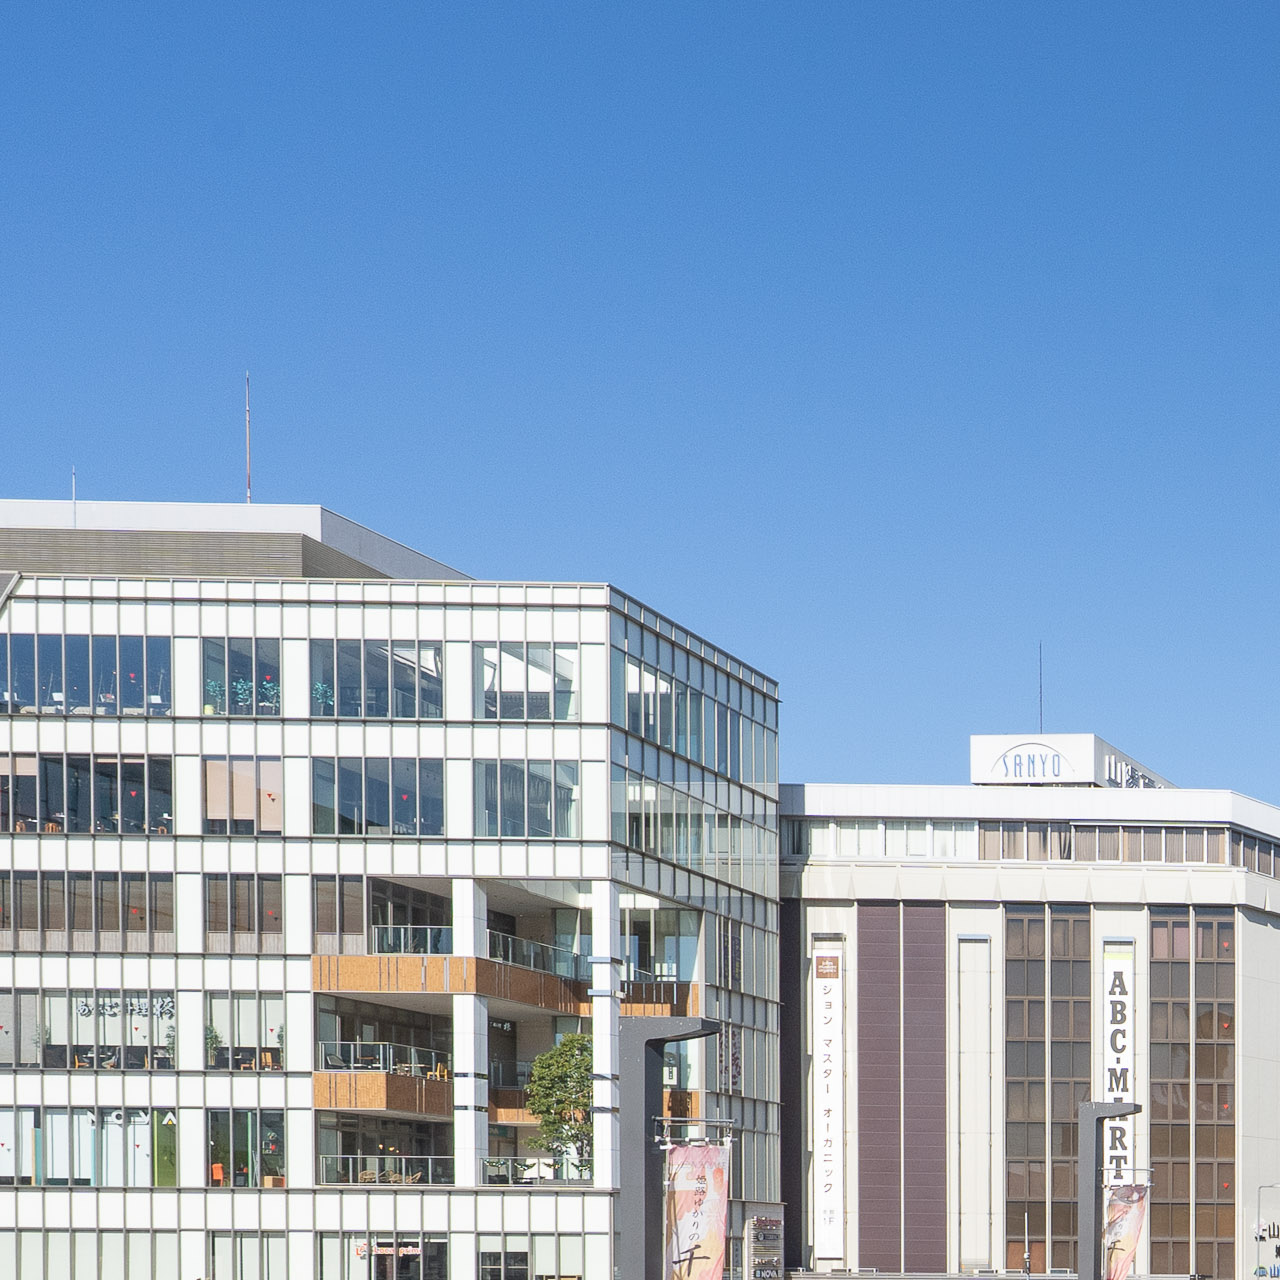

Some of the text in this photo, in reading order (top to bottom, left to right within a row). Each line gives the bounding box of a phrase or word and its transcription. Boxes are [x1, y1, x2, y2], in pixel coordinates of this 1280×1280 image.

[1002, 753, 1060, 778] SANYO
[823, 1038, 833, 1094] マスター
[822, 1107, 833, 1193] オーガニック
[688, 1175, 707, 1241] 姫路ゆかりの
